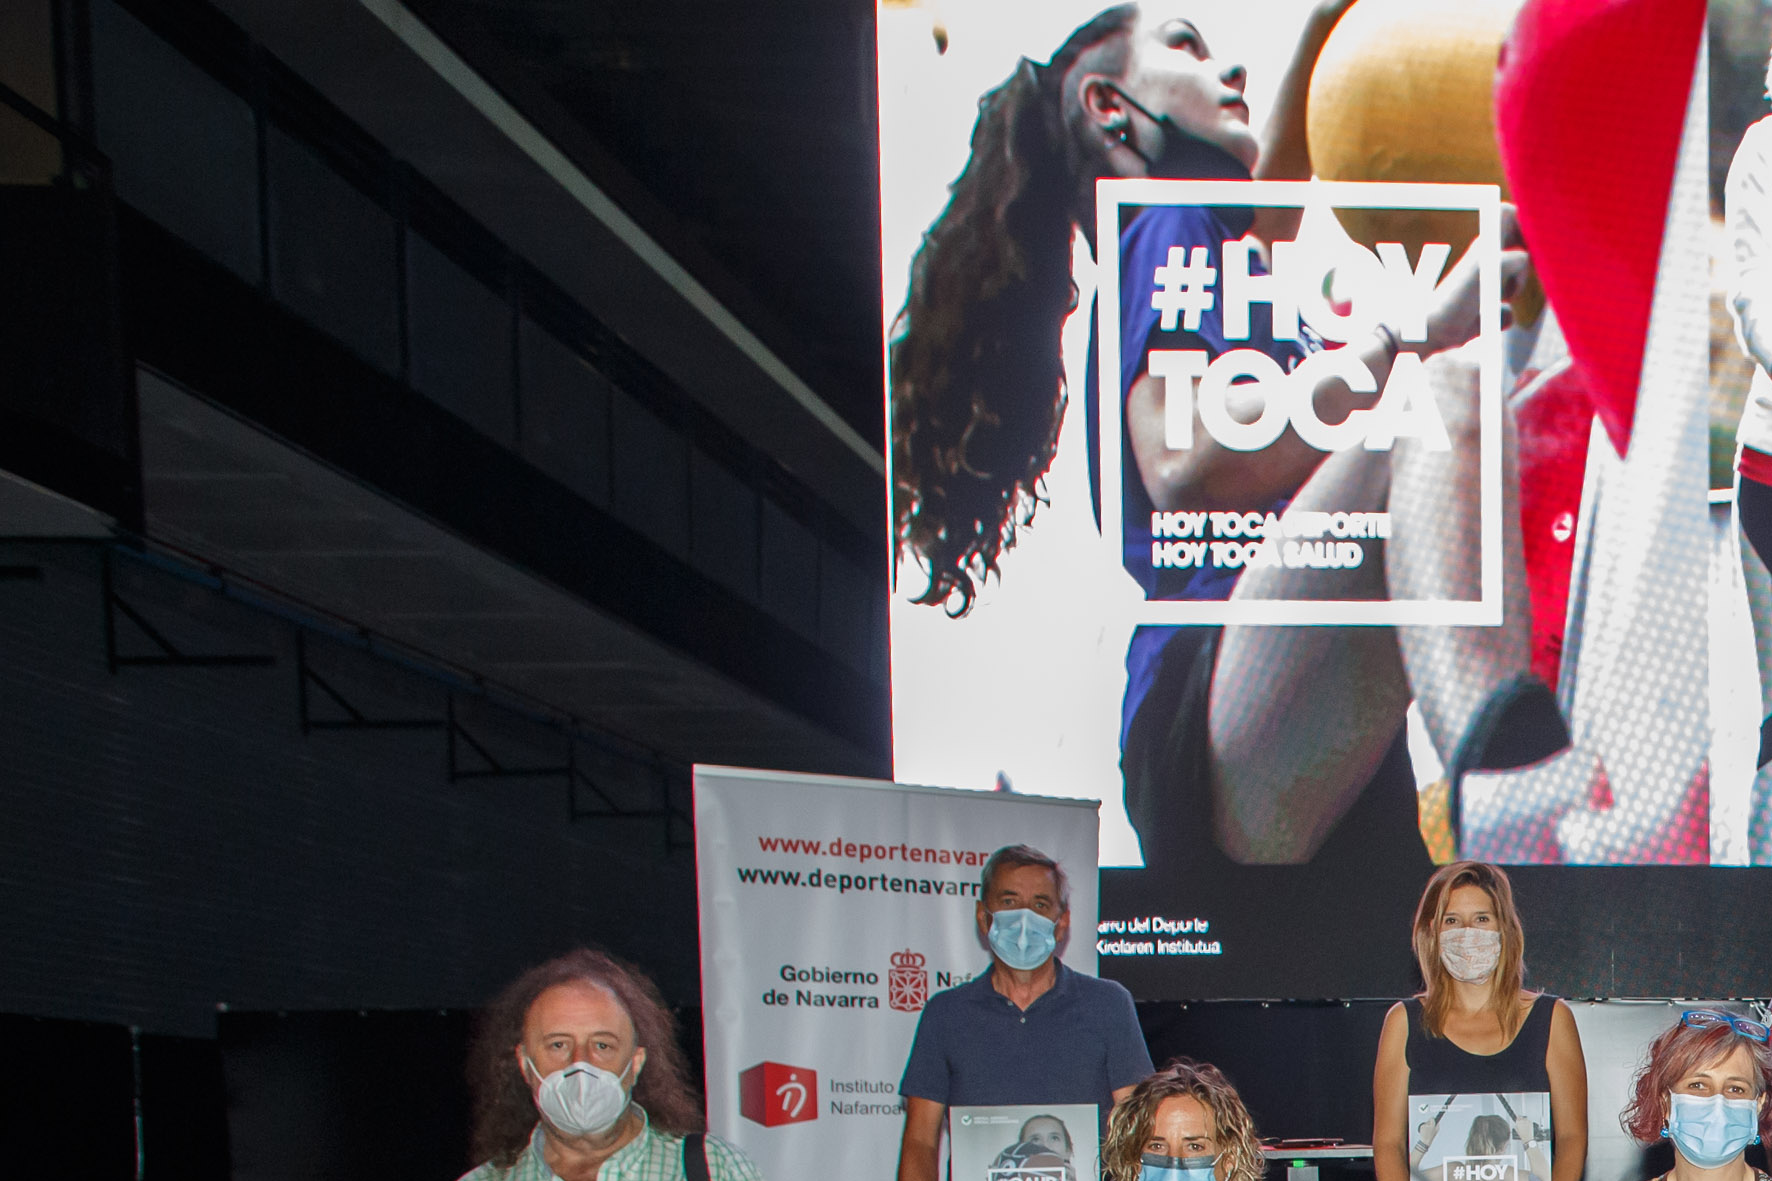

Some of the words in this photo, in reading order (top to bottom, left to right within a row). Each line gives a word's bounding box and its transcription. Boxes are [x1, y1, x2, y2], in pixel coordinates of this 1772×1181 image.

[1148, 348, 1452, 452] TOCA
[1152, 511, 1208, 538] HOY
[1209, 511, 1281, 538] TOCA
[1152, 541, 1208, 568] HOY
[1209, 541, 1282, 568] TOCA
[1283, 542, 1363, 569] SALUD
[758, 836, 991, 867] www.deportenavar
[737, 868, 982, 897] www.deportenavarr
[780, 965, 879, 985] Gobierno
[762, 989, 790, 1006] de
[795, 990, 880, 1009] Navarra
[830, 1079, 895, 1095] Instituto
[830, 1101, 908, 1117] Nafarroa
[1453, 1164, 1509, 1181] #HOY
